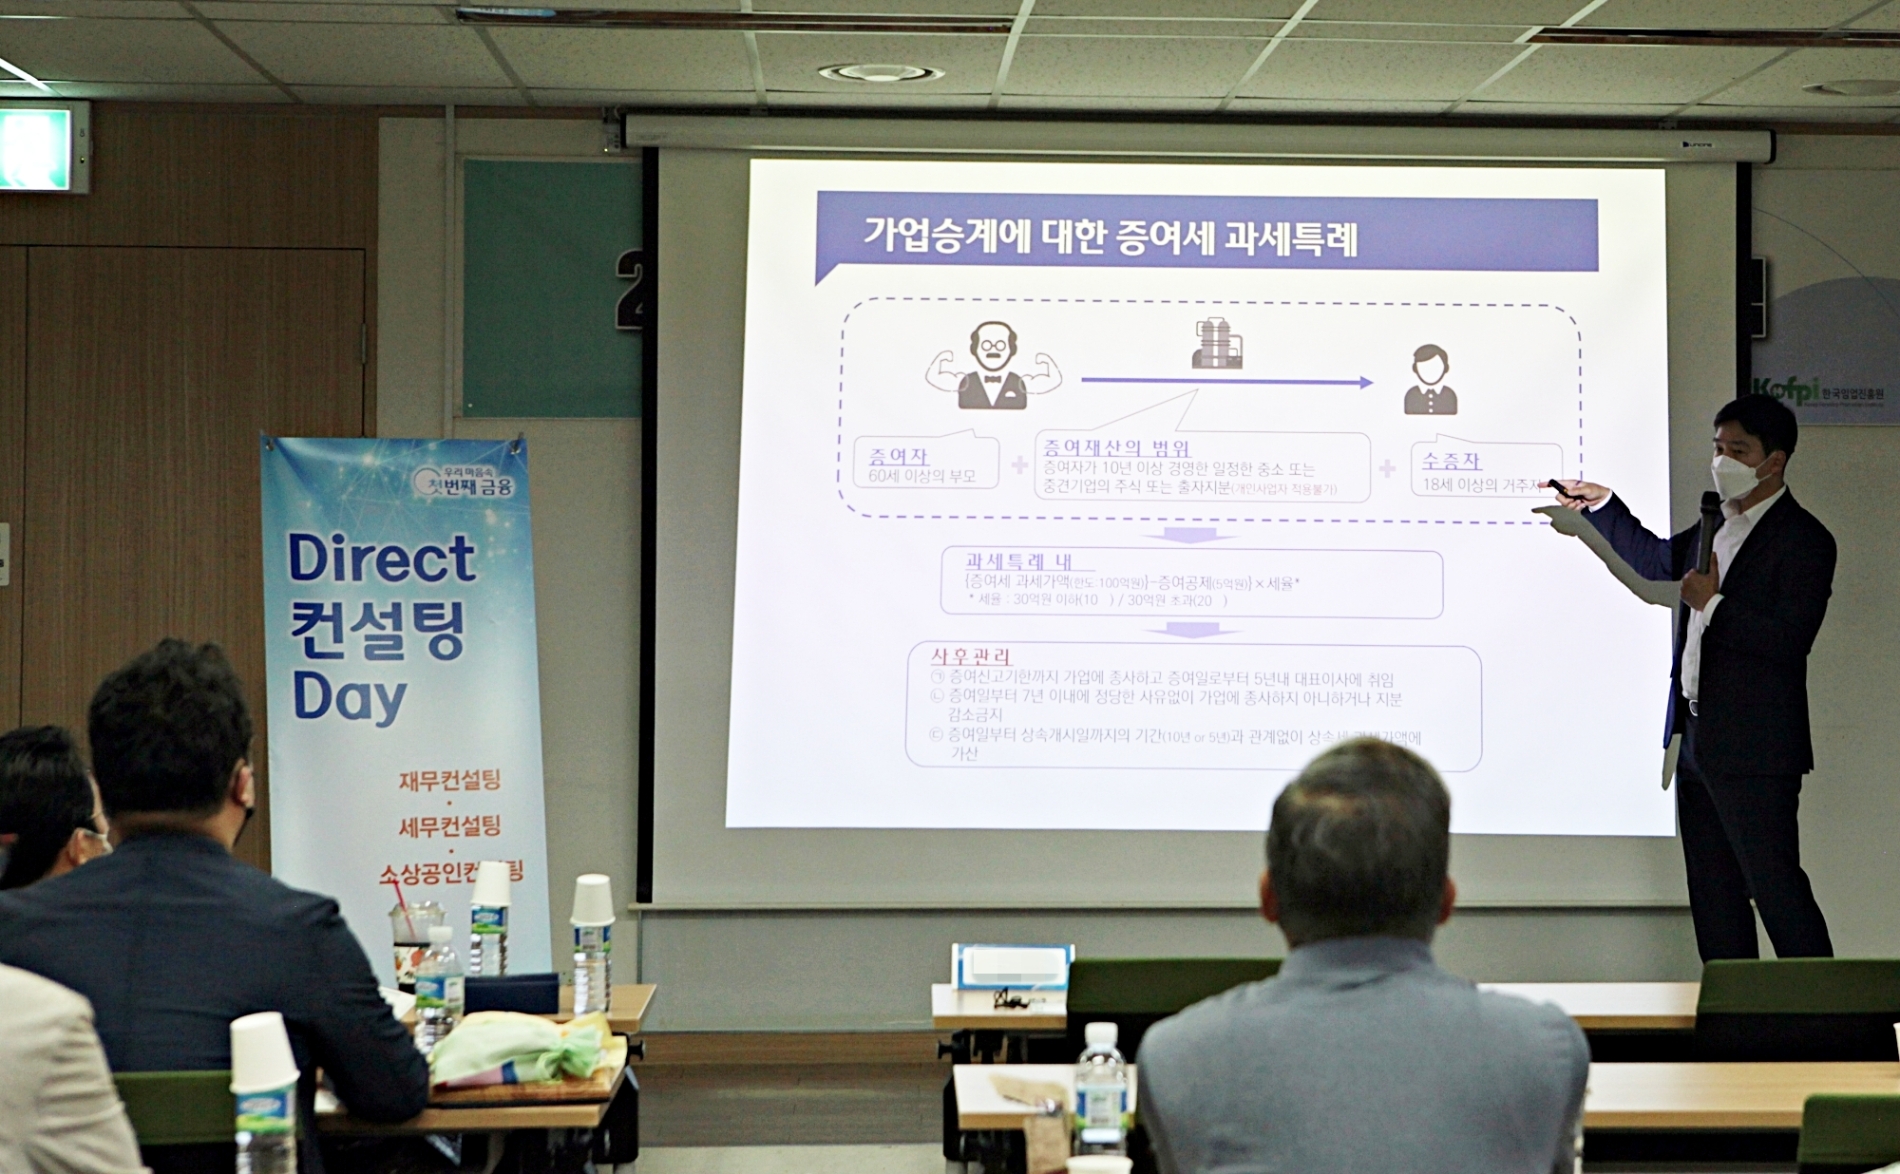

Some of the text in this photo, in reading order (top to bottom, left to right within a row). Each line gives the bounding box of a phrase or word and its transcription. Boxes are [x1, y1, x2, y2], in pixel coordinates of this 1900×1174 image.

[864, 216, 1358, 258] 가업승계에 대한 증여세 과세특례
[869, 448, 928, 466] 증여자
[1043, 439, 1190, 458] 증여재산의 범위
[1043, 460, 1316, 477] 증여자가 10년 이상 경영한 일정한 중소 또는
[1422, 452, 1480, 470] 수증자
[444, 467, 493, 478] 우리 마음속
[869, 469, 977, 484] 60세 이상의 부모
[481, 479, 513, 496] 금융
[1043, 478, 1110, 494] 중견기업의
[1115, 479, 1141, 494] 주식
[1146, 479, 1173, 494] 또는
[1423, 478, 1453, 492] 18세
[1458, 478, 1498, 493] 이상의
[289, 532, 477, 582] Direct
[966, 553, 1072, 571] 과세특례 내
[979, 593, 1001, 606] 세율
[1013, 593, 1052, 606] 30억원
[1128, 594, 1166, 607] 30억원
[291, 602, 464, 661] 컨설팅
[931, 648, 1010, 666] 사후관리
[949, 669, 1059, 685] 증여신고기한까지
[1063, 670, 1104, 685] 가업에
[1108, 670, 1163, 686] 종사하고
[1167, 670, 1249, 687] 증여일로부터
[1254, 672, 1290, 687] 5년내
[1294, 672, 1362, 688] 대표이사에
[1367, 672, 1394, 689] 취임
[293, 670, 408, 729] Day
[949, 688, 1017, 704] 증여일부터
[1022, 689, 1044, 704] 7년
[1049, 689, 1090, 704] 이내에
[1094, 689, 1135, 705] 정당한
[1139, 690, 1194, 706] 사유없이
[1199, 690, 1240, 706] 가업에
[1244, 690, 1299, 707] 종사하지
[1303, 691, 1371, 707] 아니하거나
[1375, 692, 1403, 708] 지분
[948, 707, 1003, 723] 감소금지
[948, 727, 1017, 743] 증여일부터
[1020, 727, 1131, 744] 상속개시일까지의
[1194, 734, 1206, 743] or
[1249, 729, 1303, 746] 관계없이
[952, 746, 979, 762] 가산
[399, 768, 501, 792] 재무컨설팅
[399, 814, 501, 839] 세무컨설팅
[379, 859, 524, 886] 소상공인컨팅
